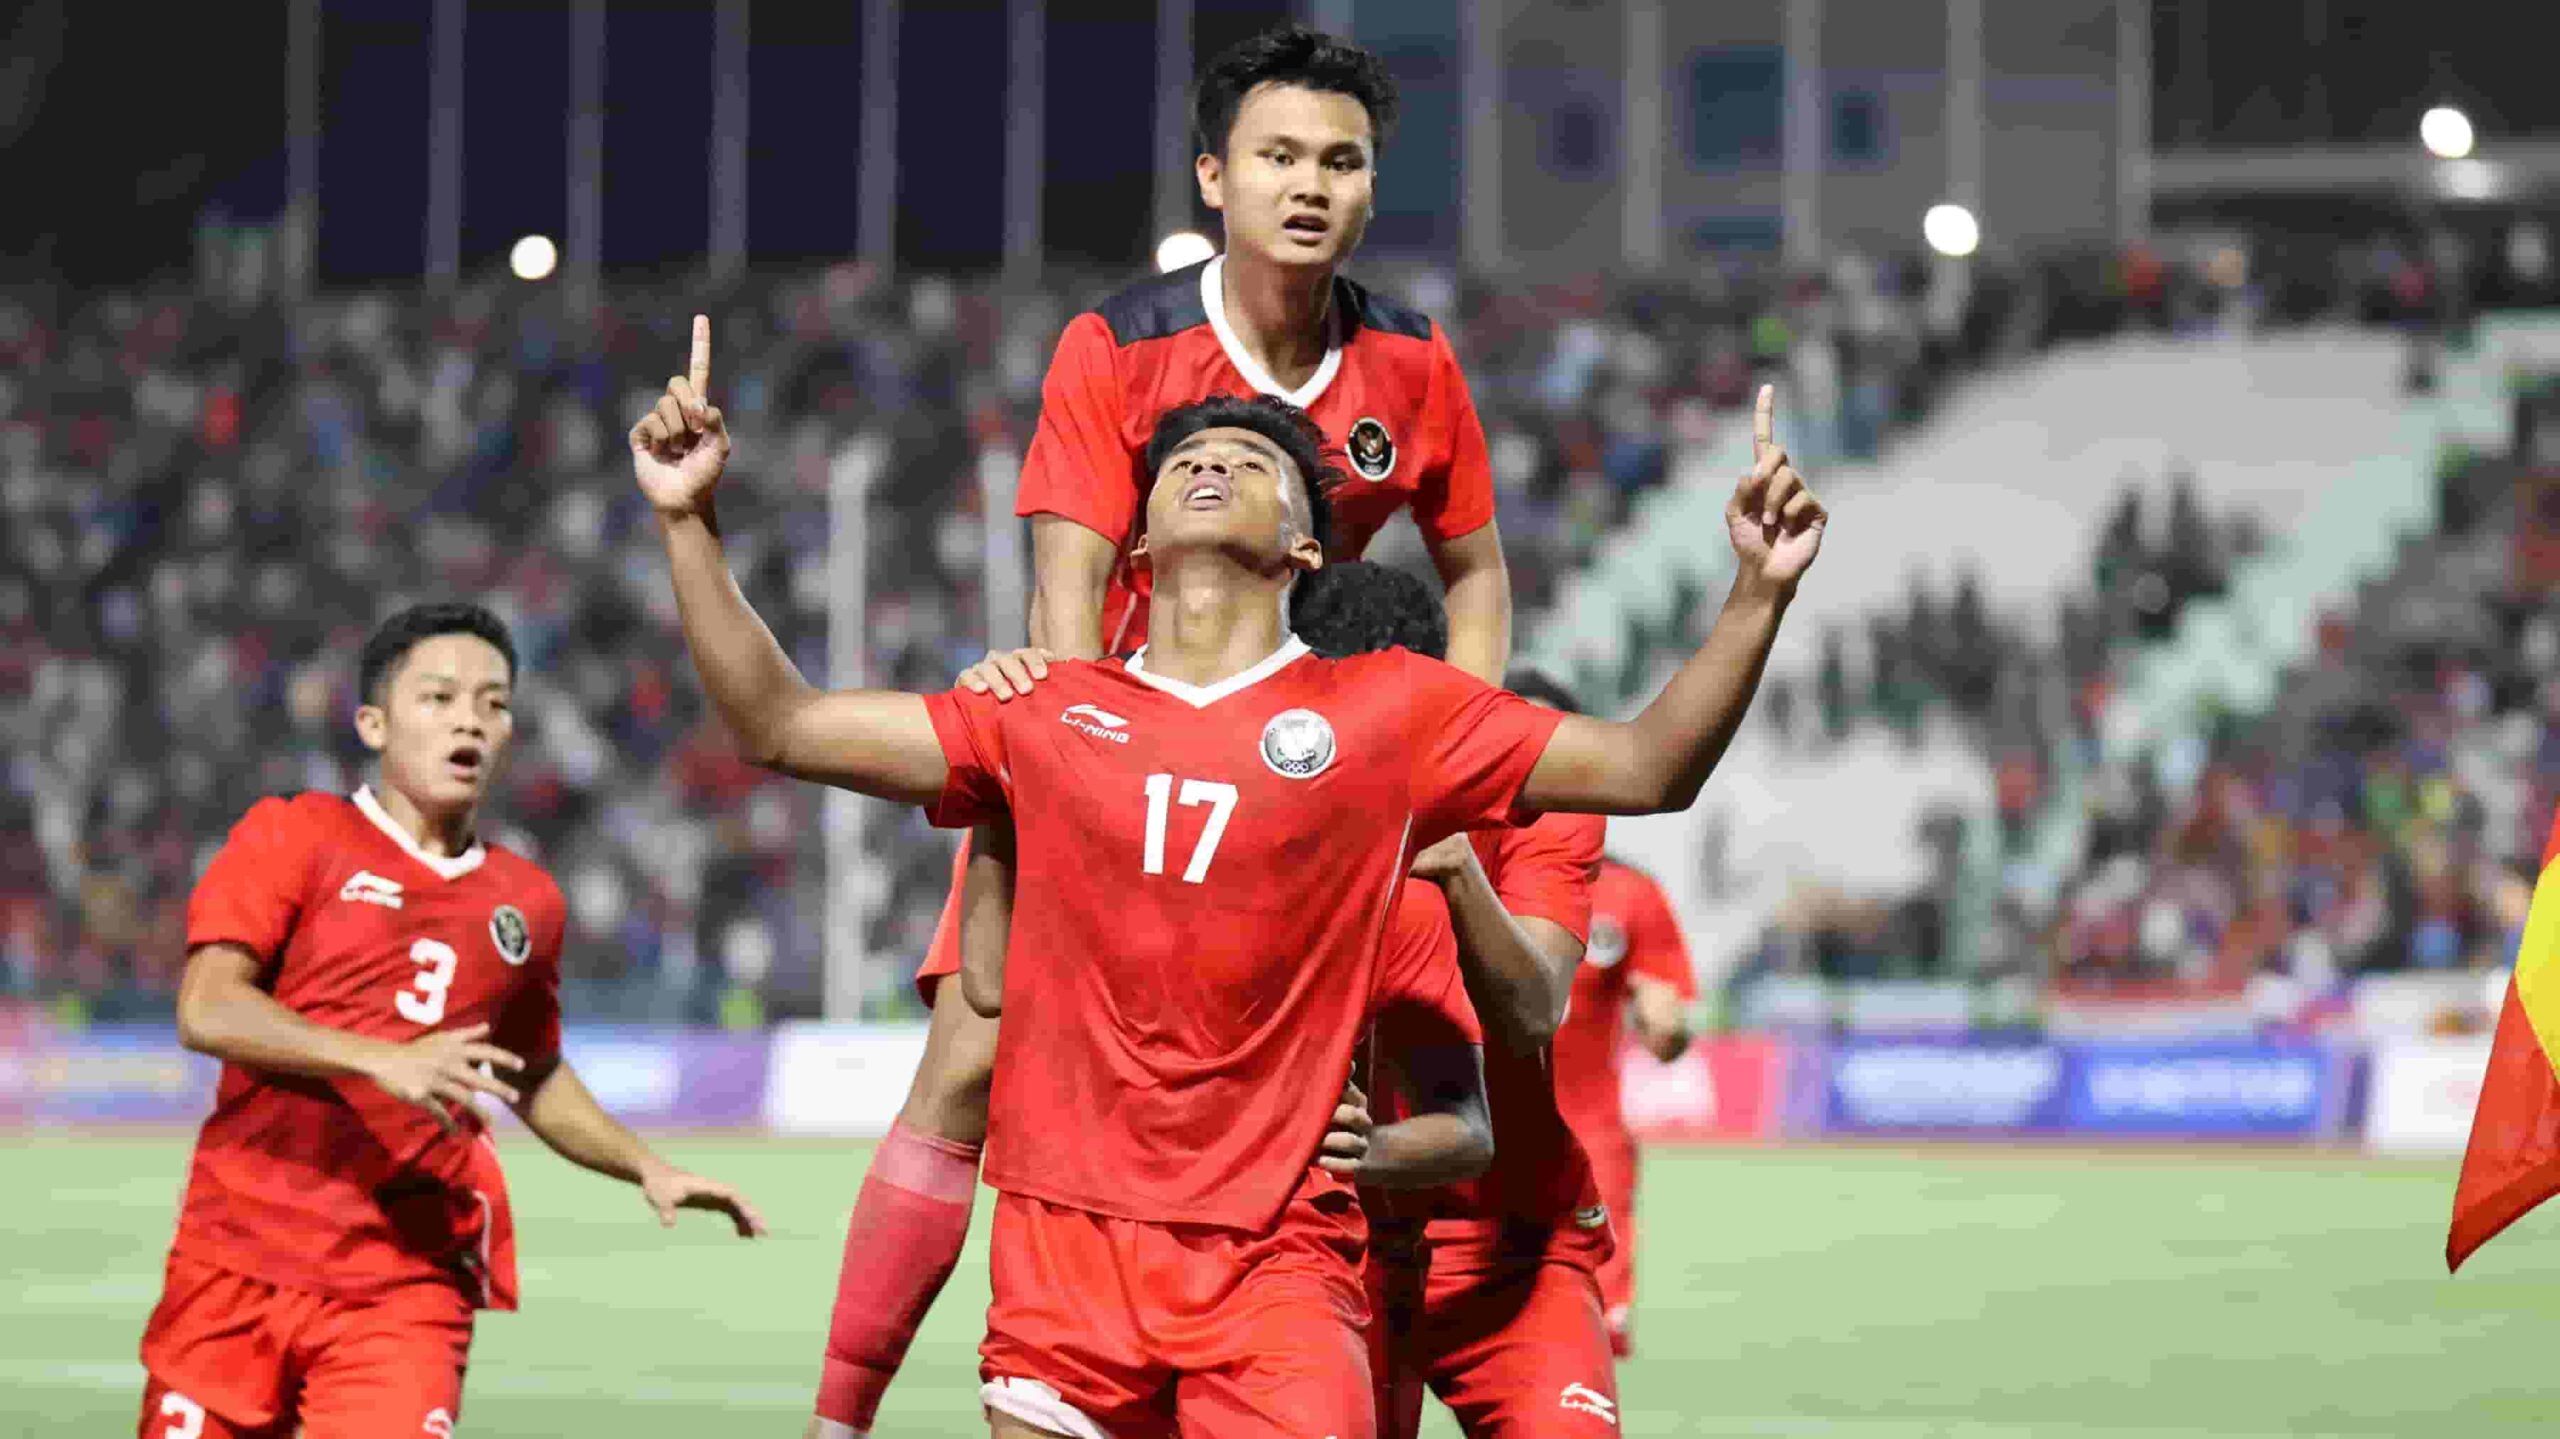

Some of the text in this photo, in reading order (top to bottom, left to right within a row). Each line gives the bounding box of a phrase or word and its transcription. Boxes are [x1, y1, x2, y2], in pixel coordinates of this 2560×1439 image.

[1060, 711, 1131, 744] LI-NING
[1143, 773, 1240, 884] 17
[395, 937, 458, 1025] 3
